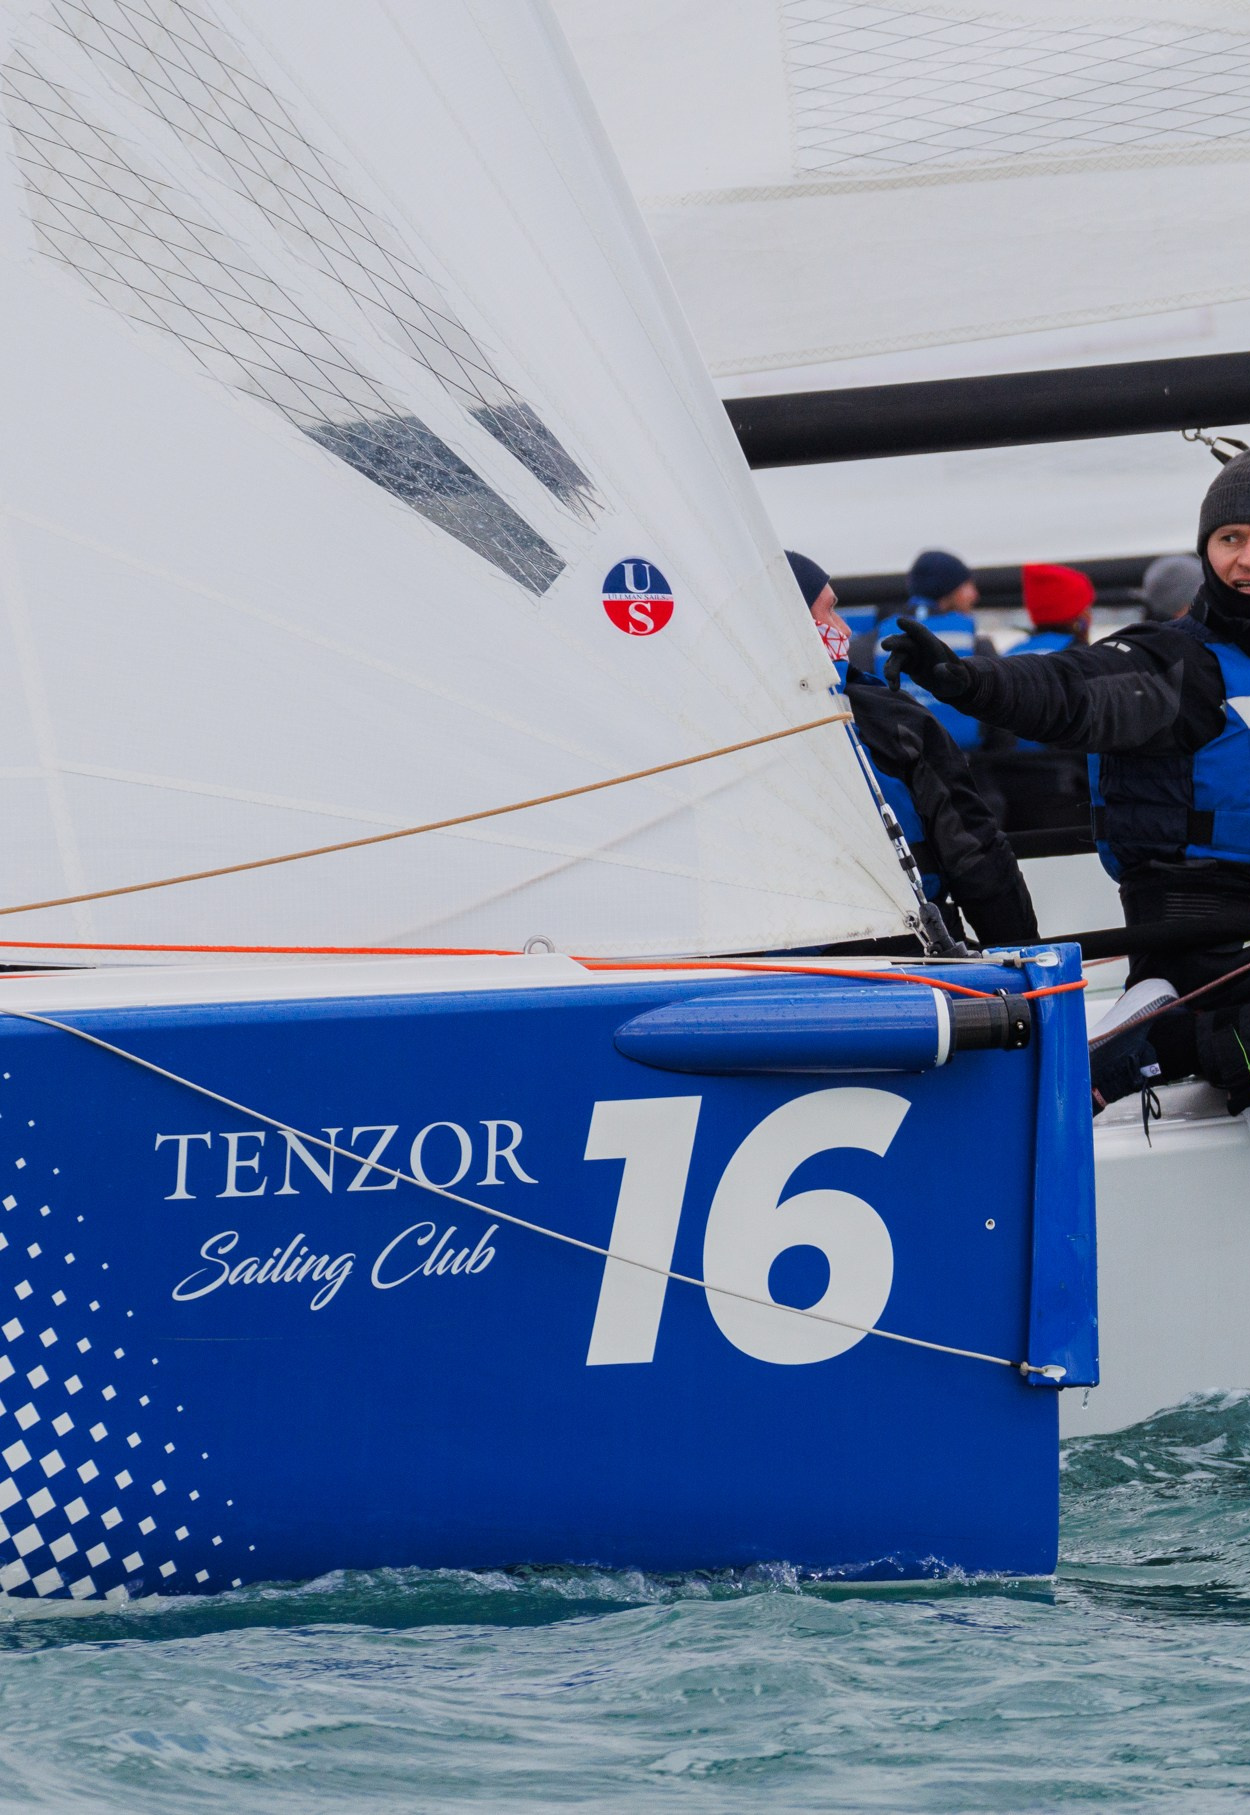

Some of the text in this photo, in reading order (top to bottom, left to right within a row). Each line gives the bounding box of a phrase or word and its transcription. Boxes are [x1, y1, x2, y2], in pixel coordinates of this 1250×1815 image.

[154, 1119, 539, 1200] TENZOR
[171, 1221, 500, 1311] Sailing Club
[583, 1086, 912, 1366] 16
